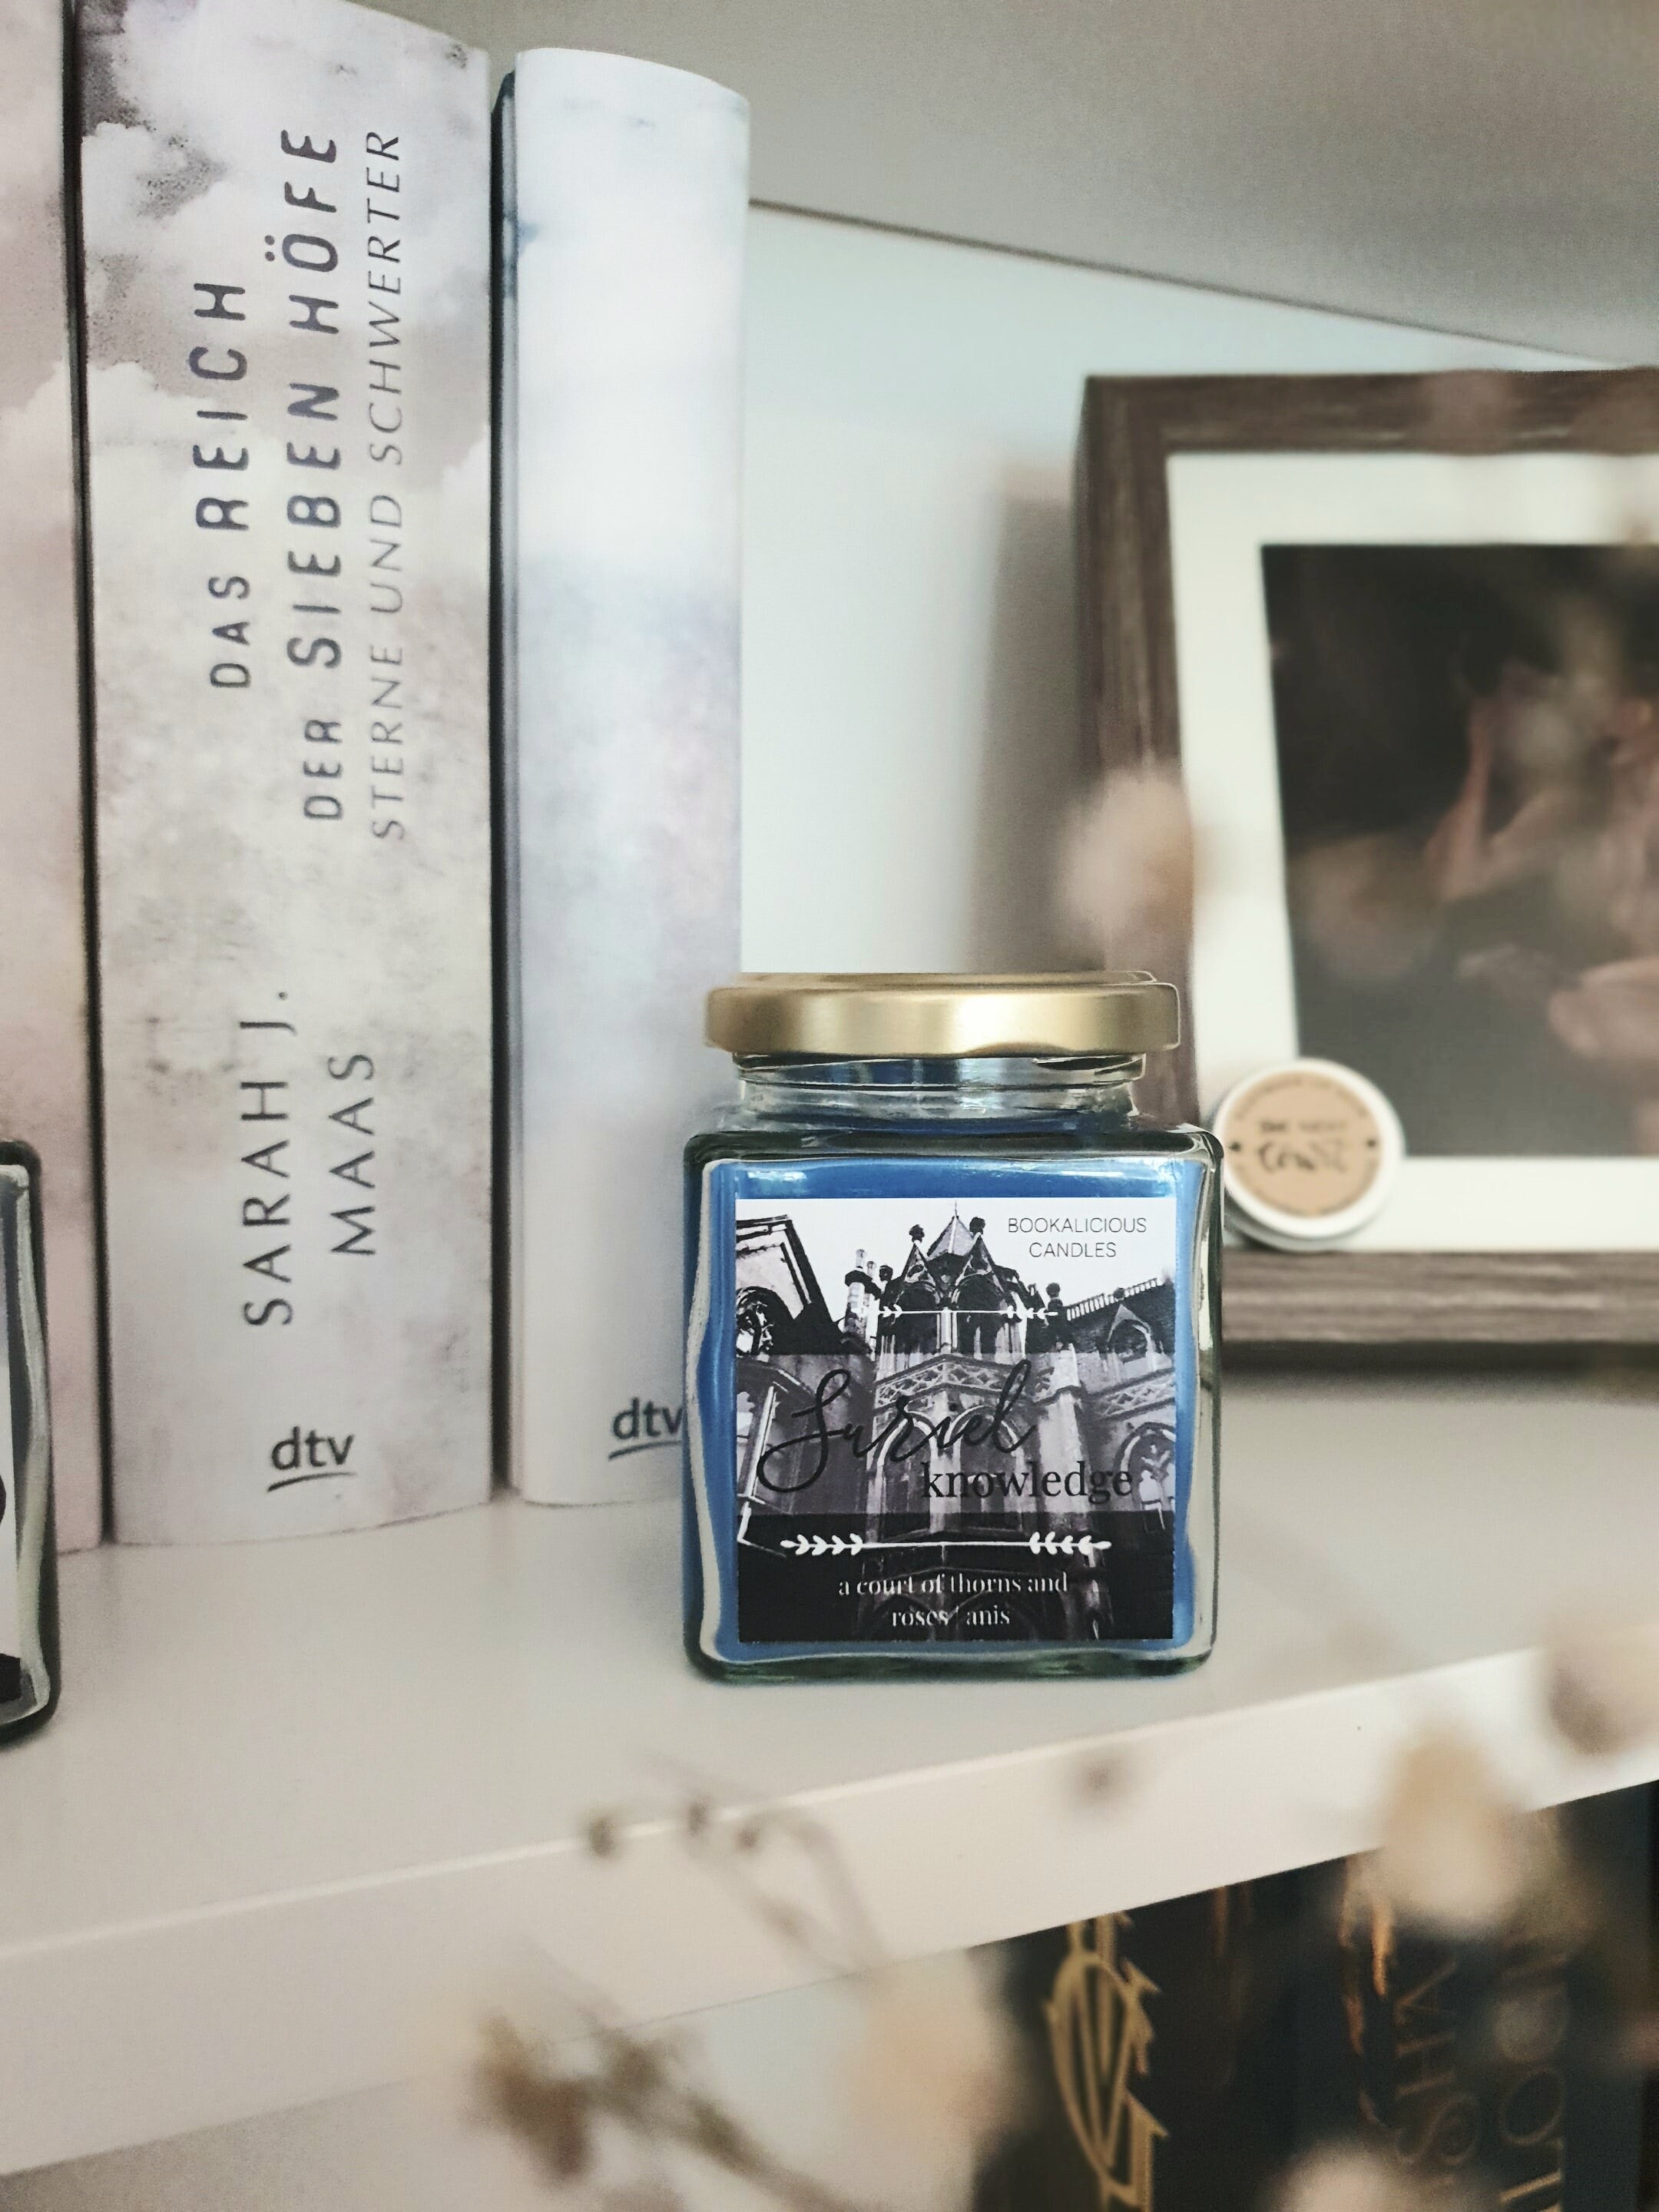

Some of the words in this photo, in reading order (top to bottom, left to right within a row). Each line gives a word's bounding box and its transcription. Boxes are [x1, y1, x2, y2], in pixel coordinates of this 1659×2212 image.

[263, 127, 340, 336] HÖFE
[364, 129, 406, 468] SCHWERTER
[189, 280, 250, 533] REICH
[285, 381, 343, 670] SIEBEN
[364, 493, 406, 615] UND
[207, 574, 253, 690] DAS
[302, 719, 344, 824] DER
[367, 644, 408, 842] STERNE
[238, 990, 298, 1036] J.
[238, 1079, 294, 1328] SARAH
[327, 1052, 376, 1257] MAAS
[1007, 1216, 1147, 1234] BOOKALICIOUS
[1028, 1241, 1118, 1259] CANDLES
[271, 1426, 356, 1473] dtv
[613, 1396, 684, 1440] dtv
[921, 1460, 1134, 1505] knowledge
[838, 1580, 850, 1596] a
[856, 1575, 914, 1596] court
[921, 1572, 945, 1594] of
[950, 1572, 1022, 1594] thorns
[1027, 1571, 1068, 1593] and
[891, 1608, 949, 1628] roses
[965, 1604, 1011, 1627] anis
